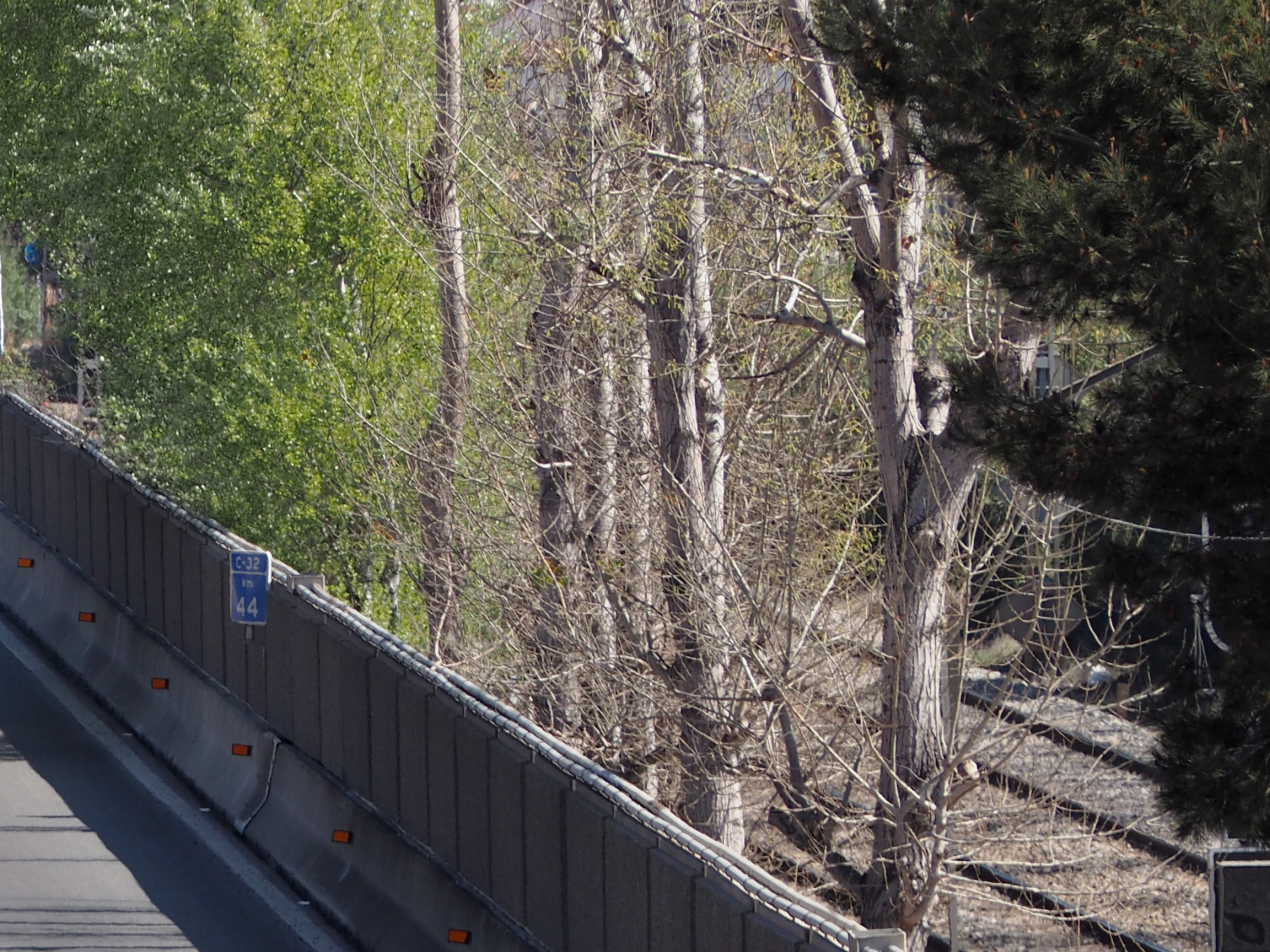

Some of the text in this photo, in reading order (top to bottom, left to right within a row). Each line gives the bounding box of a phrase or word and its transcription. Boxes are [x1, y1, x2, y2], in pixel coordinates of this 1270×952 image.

[235, 556, 260, 570] C-32
[241, 578, 254, 589] km
[236, 596, 259, 618] 44
